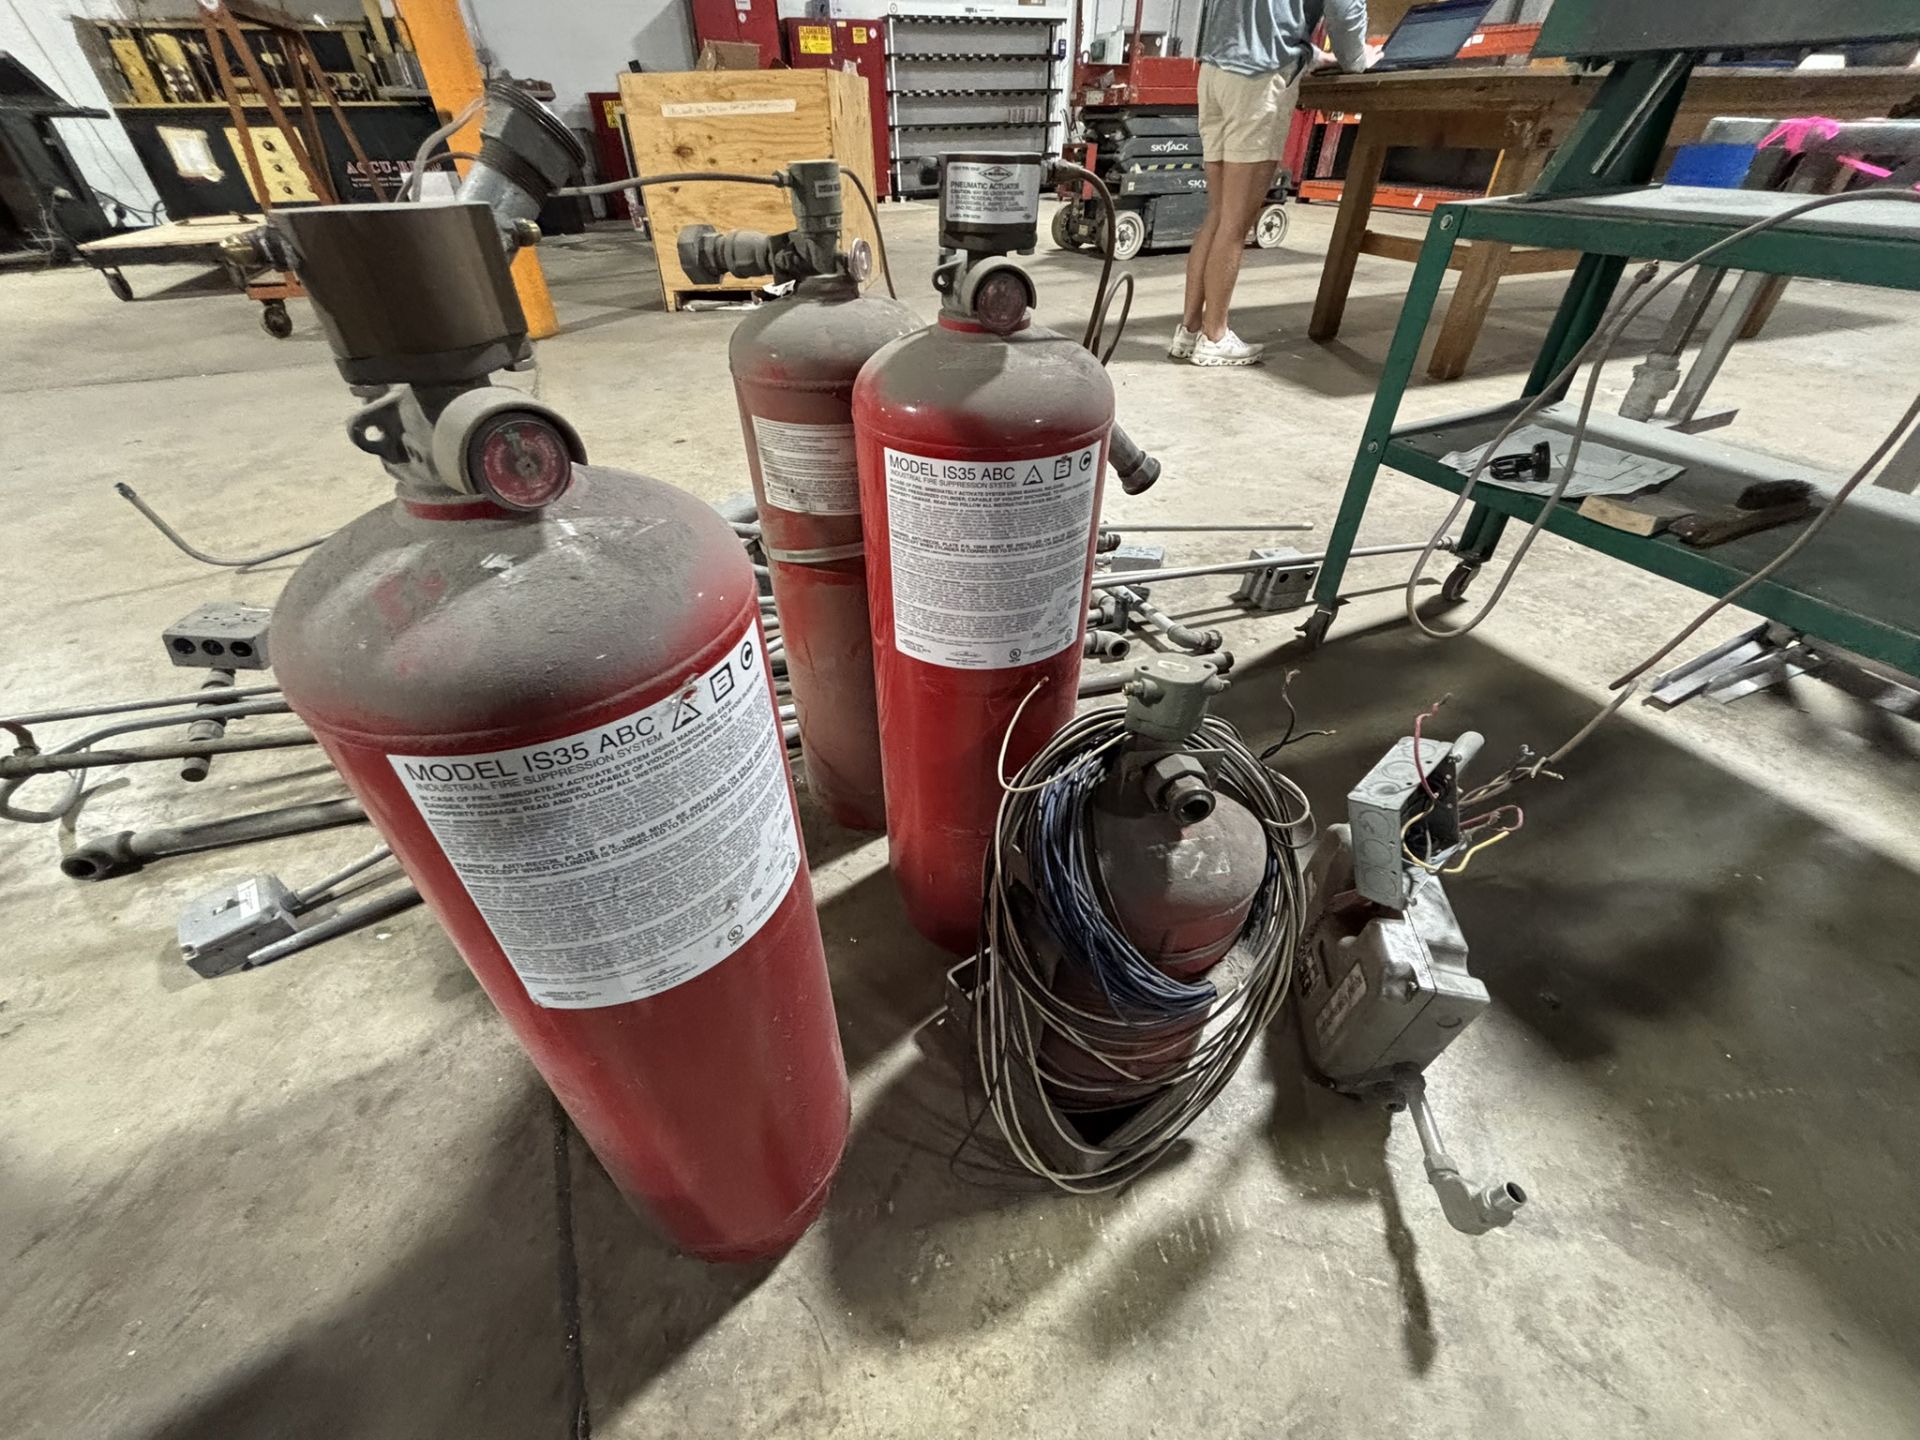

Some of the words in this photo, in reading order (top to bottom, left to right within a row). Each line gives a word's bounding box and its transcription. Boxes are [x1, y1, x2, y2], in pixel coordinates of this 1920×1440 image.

[1151, 140, 1189, 153] SKYJACK
[889, 454, 938, 477] MODEL
[943, 464, 977, 481] IS35
[981, 466, 1016, 480] ABC
[890, 469, 921, 483] INDUSTRIAL
[923, 476, 937, 486] FIRE
[939, 479, 987, 489] SUPPRESSION
[404, 759, 518, 782] MODEL
[522, 741, 590, 773] IS35
[599, 715, 655, 754] ABC
[415, 782, 489, 793] INDUSTRIAL
[490, 778, 521, 789] FIRE
[522, 753, 615, 785] SUPPRESSION
[616, 731, 664, 759] SYSTEM
[566, 768, 613, 787] ACTIVATE
[614, 752, 650, 771] SYSTEM
[651, 739, 676, 756] USING
[676, 721, 706, 742] MANUAL
[587, 769, 630, 789] CAPABLE
[631, 762, 644, 773] OF
[645, 745, 679, 767] VIOLENT
[522, 802, 550, 812] READ
[552, 796, 573, 807] AND
[574, 783, 614, 800] FOLLOW
[616, 777, 633, 788] ALL
[634, 747, 692, 780] INSTRUCTIONS
[551, 854, 599, 870] CYLINDER
[611, 828, 666, 855] CONNECTED
[667, 821, 680, 831] TO
[564, 849, 595, 861] PLATE
[648, 819, 673, 833] MUST
